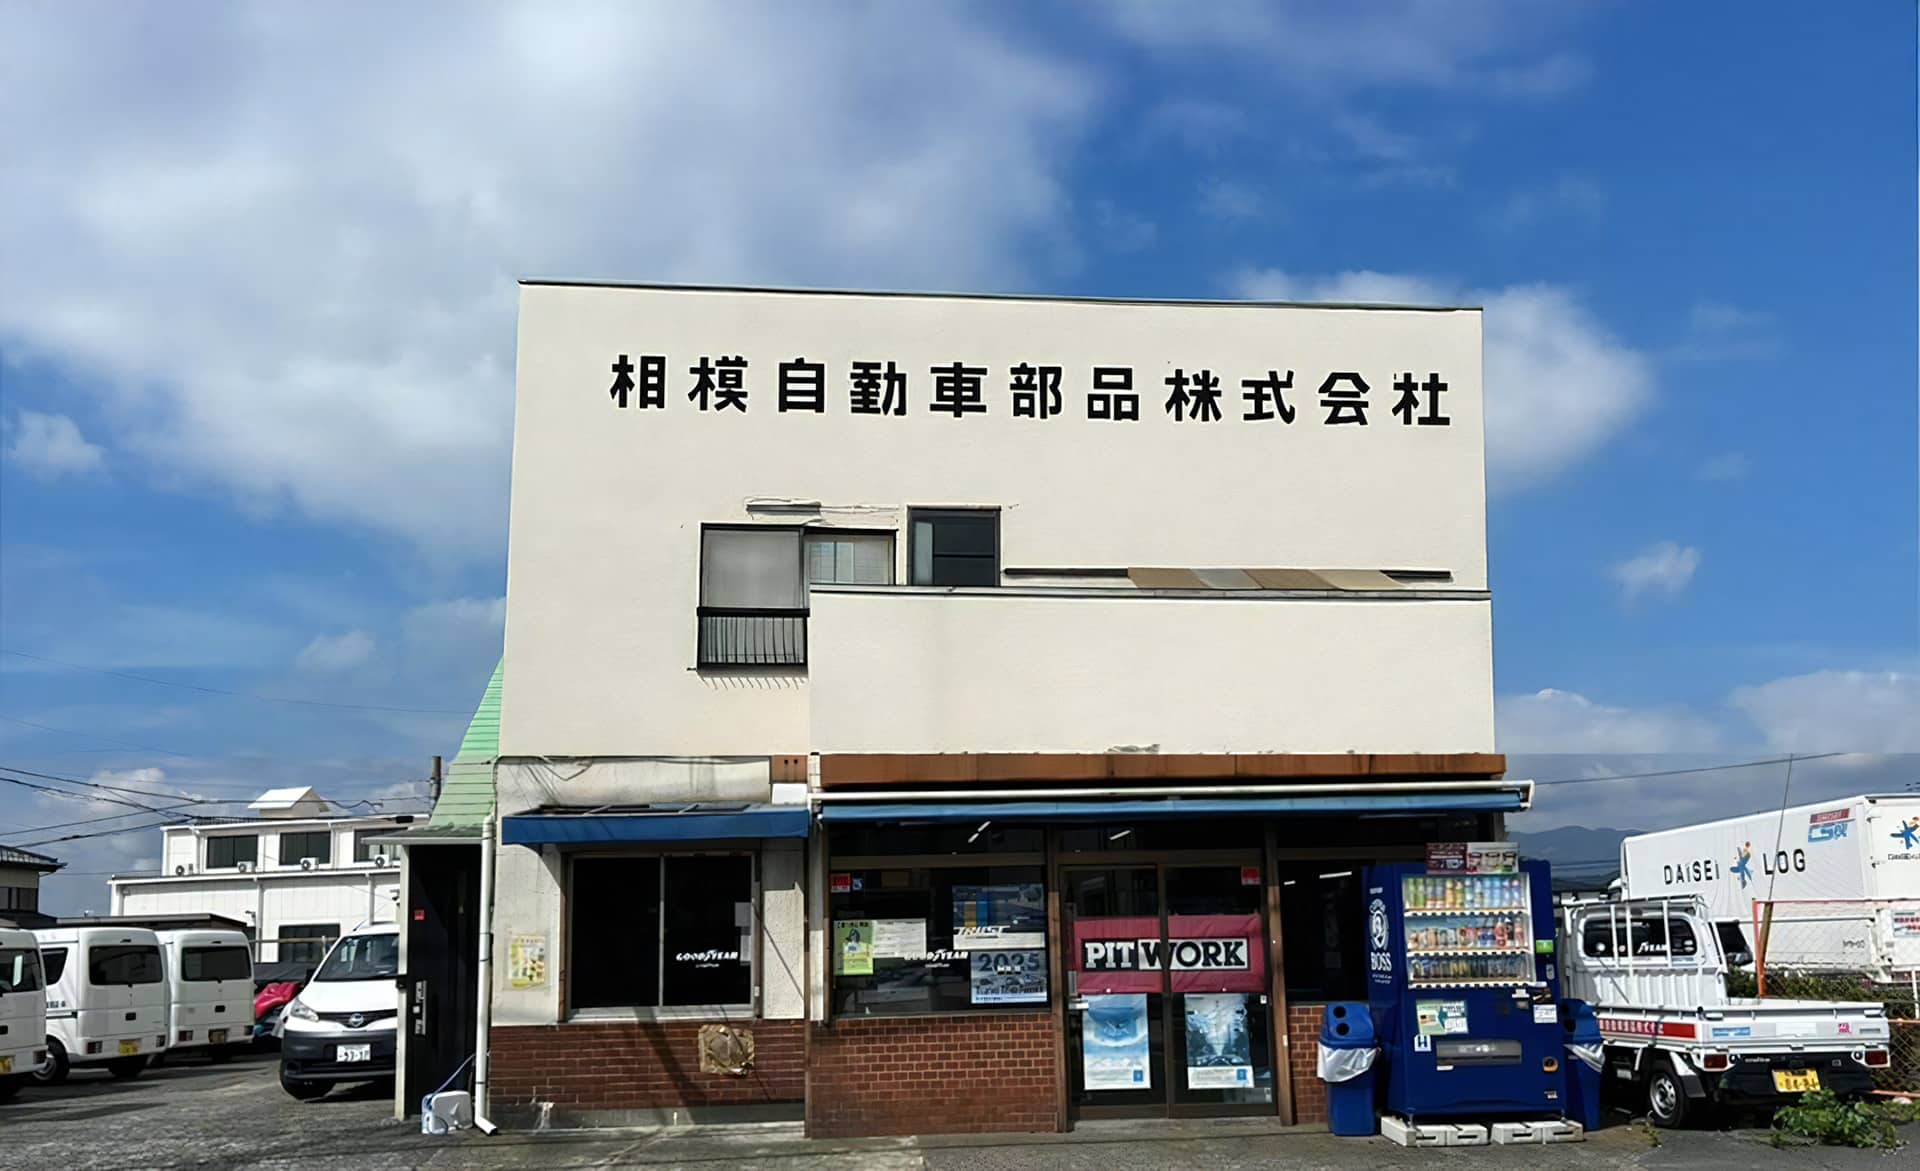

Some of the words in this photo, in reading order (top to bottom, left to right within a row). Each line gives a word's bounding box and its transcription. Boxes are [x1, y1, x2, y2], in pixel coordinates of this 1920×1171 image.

[610, 354, 1450, 426] 相模自動車部品株式会社
[1762, 848, 1806, 875] LOG
[676, 949, 738, 962] GOODYEAR
[978, 953, 1040, 971] 2025
[1370, 951, 1393, 972] BOSS
